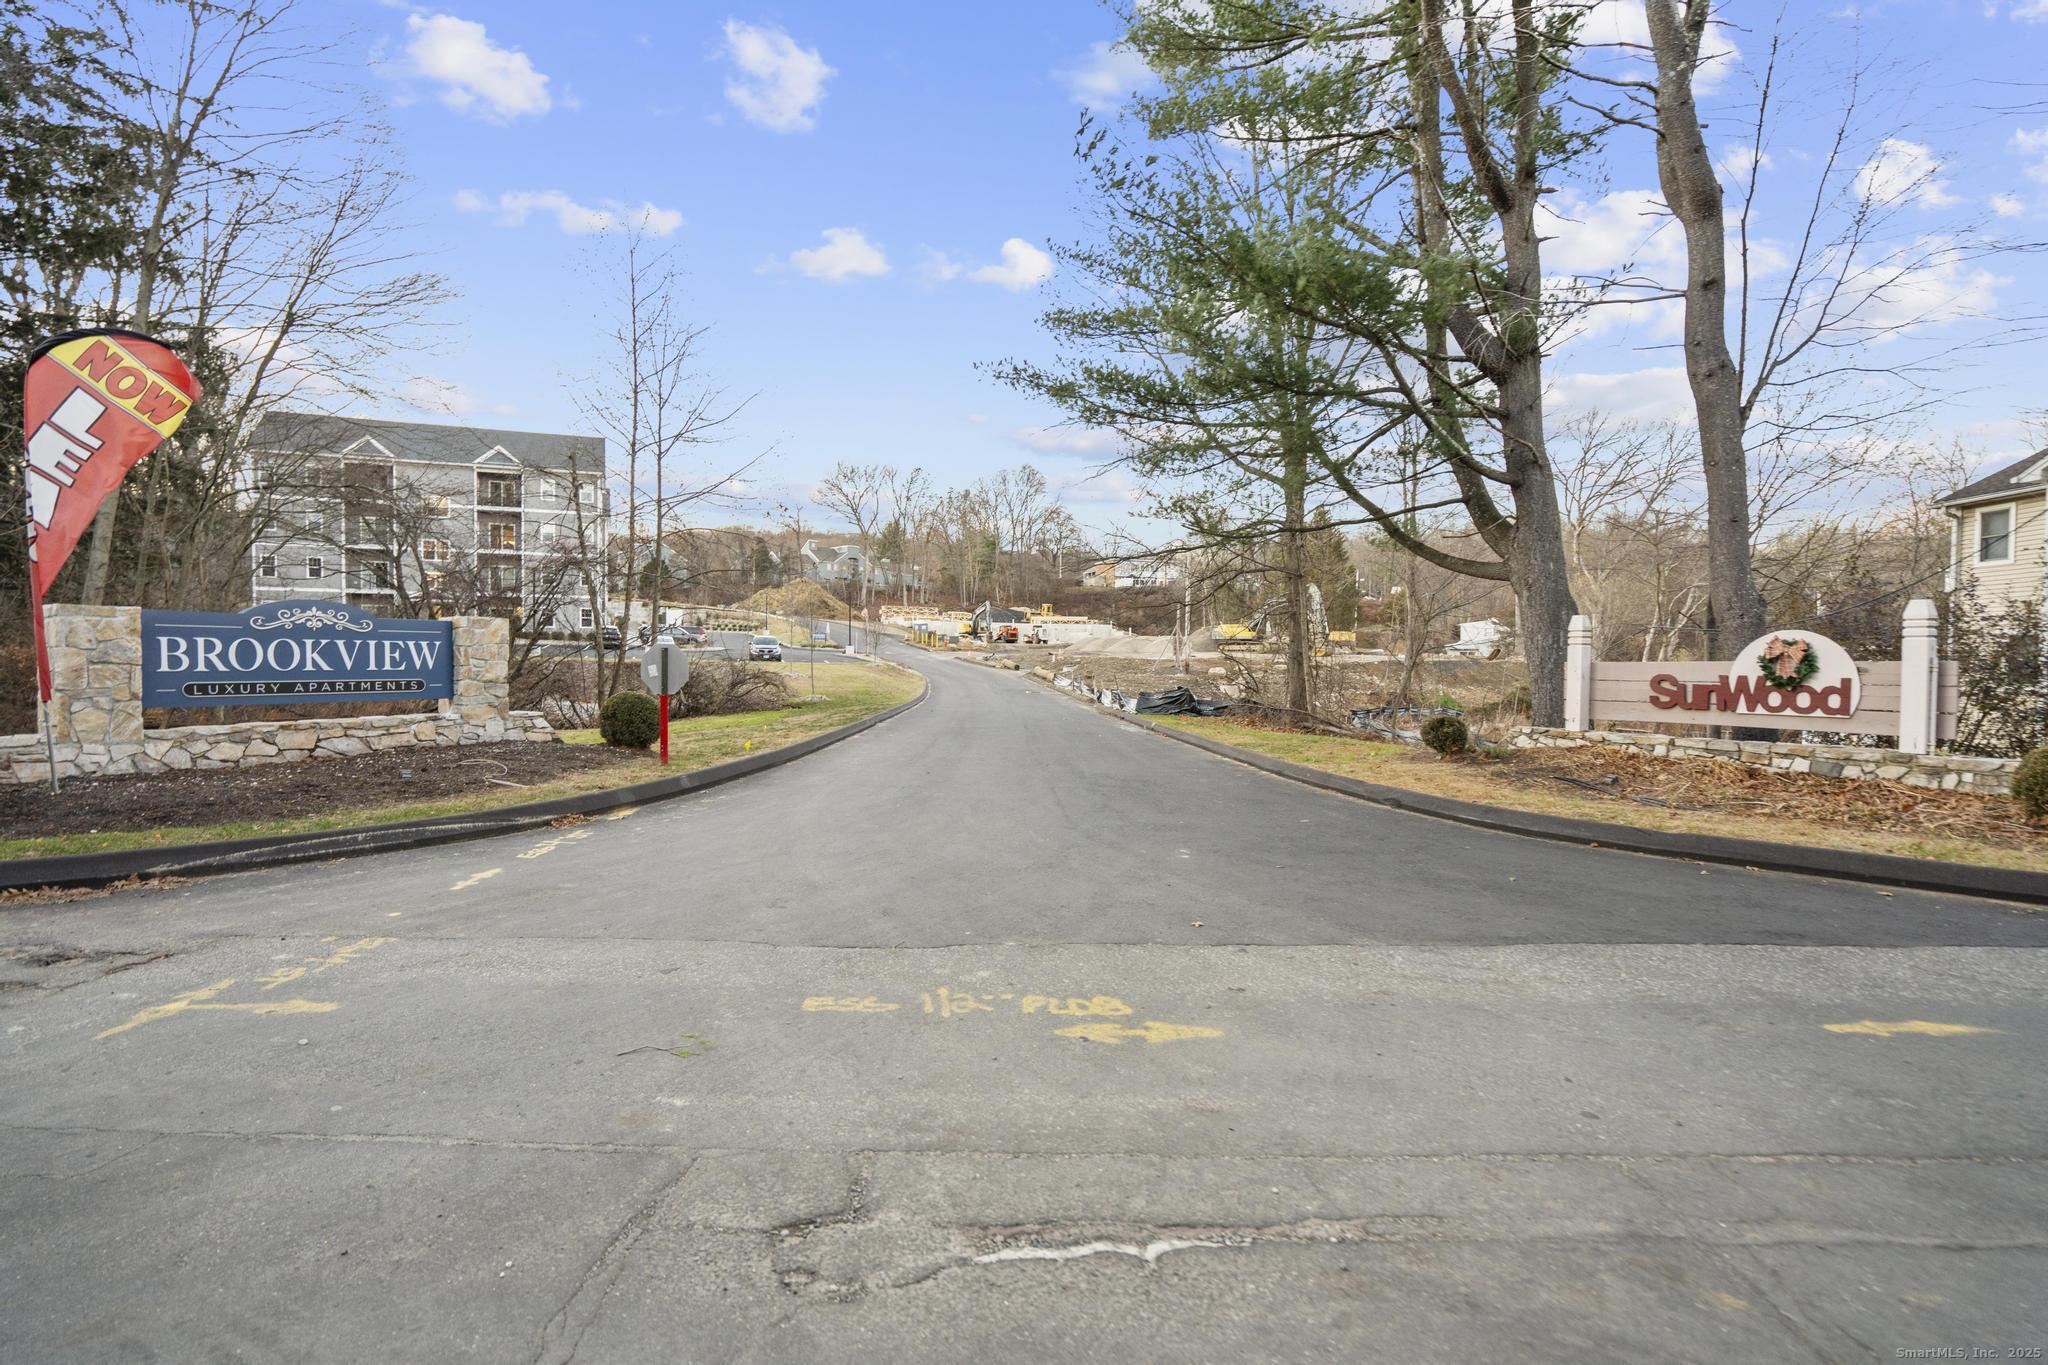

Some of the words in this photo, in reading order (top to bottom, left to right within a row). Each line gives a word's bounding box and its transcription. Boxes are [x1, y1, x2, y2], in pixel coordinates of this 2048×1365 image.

[73, 339, 187, 425] NOW
[156, 636, 442, 672] BROOKVIEW
[193, 683, 280, 695] LUXURY
[294, 680, 418, 693] APARTMENTS
[1649, 674, 1852, 716] SunWood
